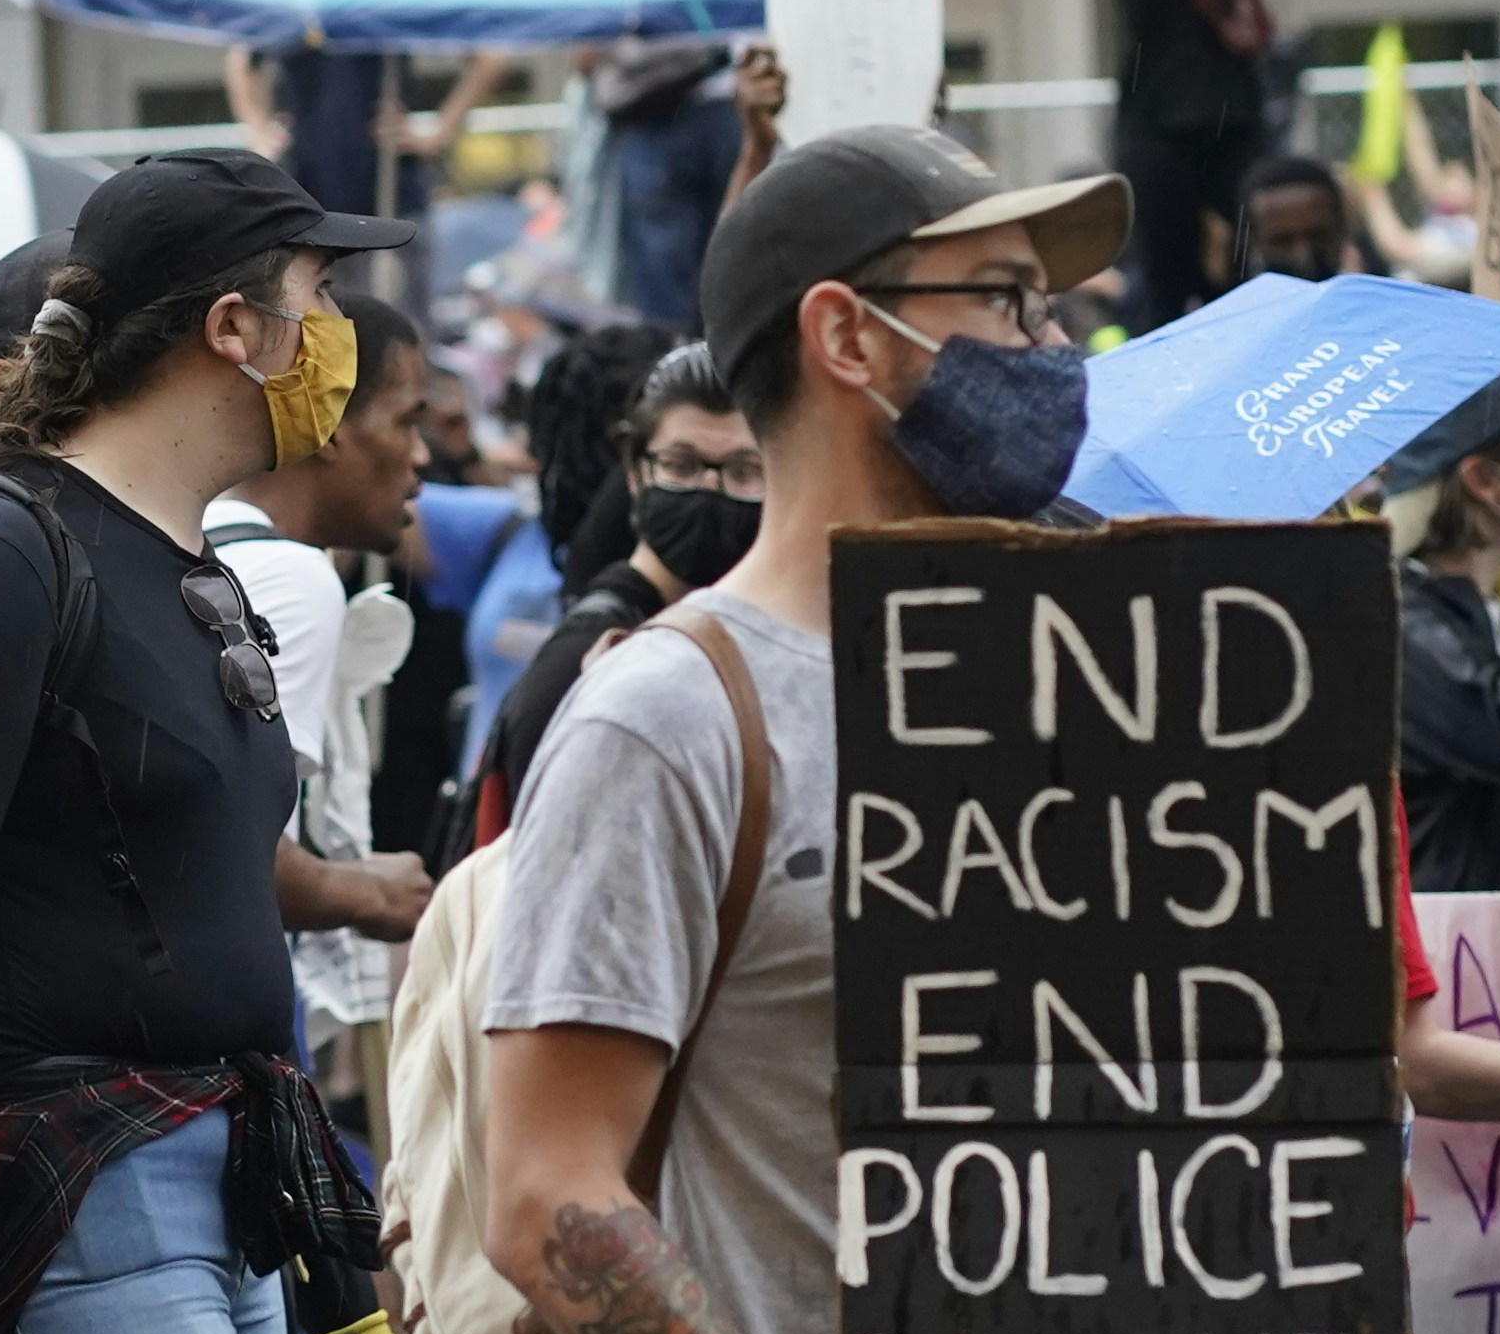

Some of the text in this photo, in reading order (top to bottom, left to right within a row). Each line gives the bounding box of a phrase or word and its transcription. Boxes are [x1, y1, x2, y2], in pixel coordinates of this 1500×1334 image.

[1235, 341, 1341, 423] GRAND
[1248, 338, 1402, 456] EUROPEAN
[1302, 378, 1415, 458] TRAVEL
[885, 585, 1315, 750] END
[846, 779, 1382, 928] RACISM
[902, 966, 1284, 1121] END
[835, 1133, 1367, 1300] POLICE
